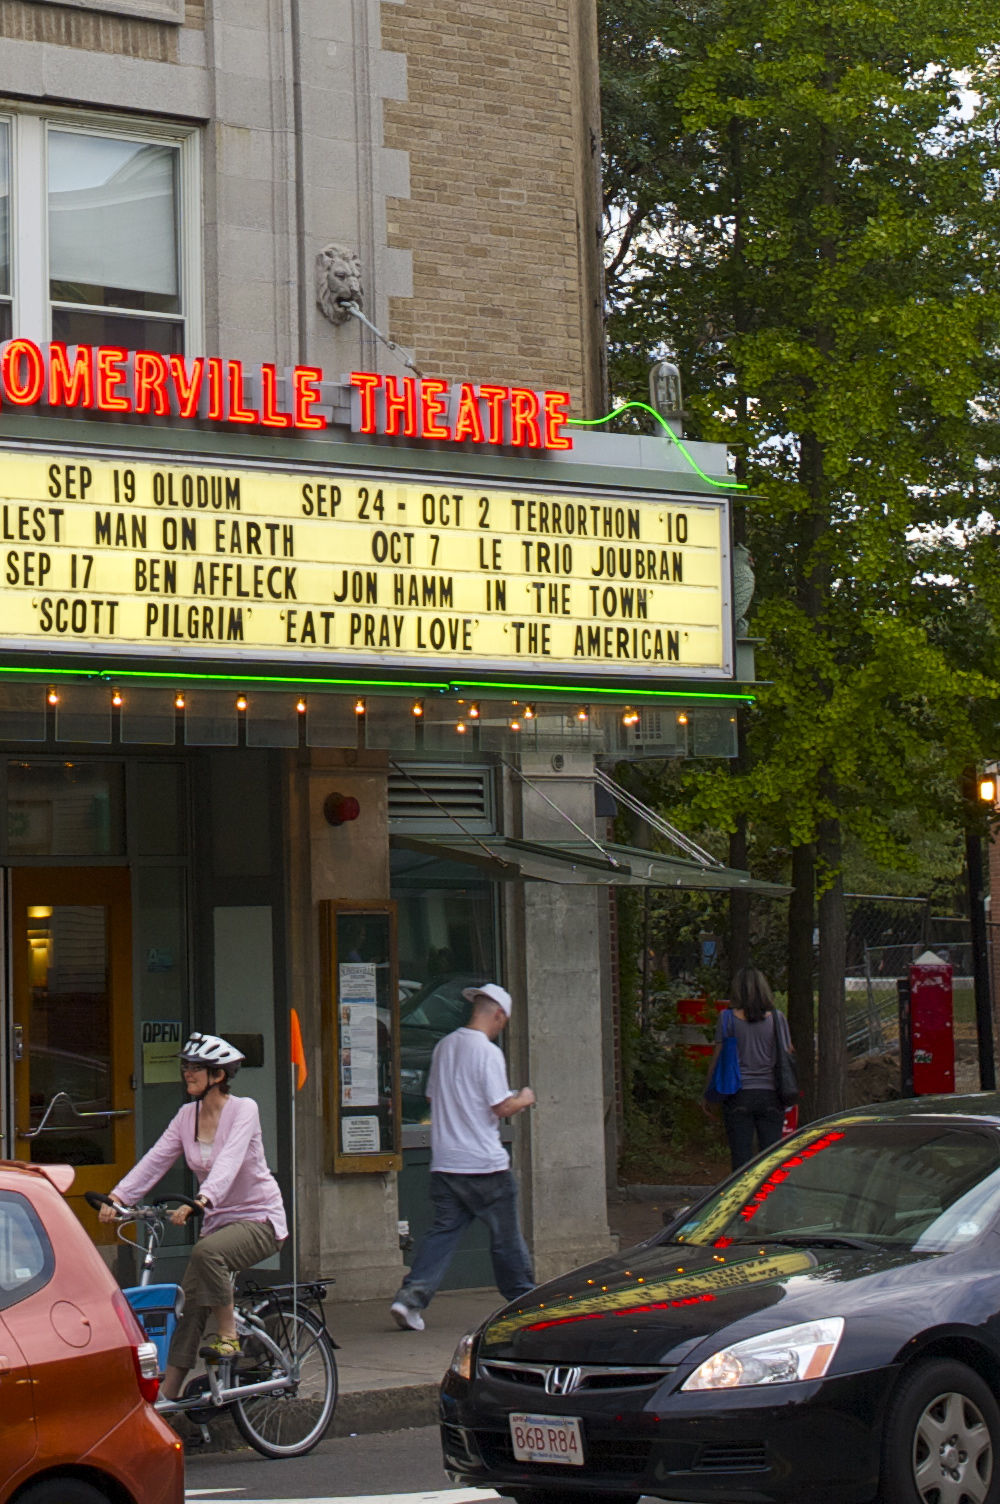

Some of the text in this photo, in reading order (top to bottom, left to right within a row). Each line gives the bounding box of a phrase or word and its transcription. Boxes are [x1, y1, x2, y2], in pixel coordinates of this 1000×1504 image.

[349, 372, 574, 451] THEATRE
[49, 464, 240, 510] SEP 19 OLODUM
[96, 512, 146, 548] MAN
[163, 518, 196, 550] ON
[216, 520, 293, 556] EARTH
[303, 484, 341, 517] SEP
[359, 488, 384, 520] 24
[423, 494, 463, 526] OCT
[479, 497, 489, 528] 2
[512, 500, 639, 539] TERRORTHON
[372, 531, 682, 582] OCT 7 LE TRIO JOUBRAN
[7, 551, 50, 586] SEP
[72, 555, 93, 588] 17
[136, 559, 176, 593] BEN
[194, 562, 296, 599] AFFLECK
[334, 571, 377, 604] JON
[395, 574, 452, 607] HAMM
[487, 580, 505, 611] IN
[351, 613, 403, 647] PRAY
[142, 1022, 180, 1043] OPEN
[514, 1426, 578, 1454] 86B R84
